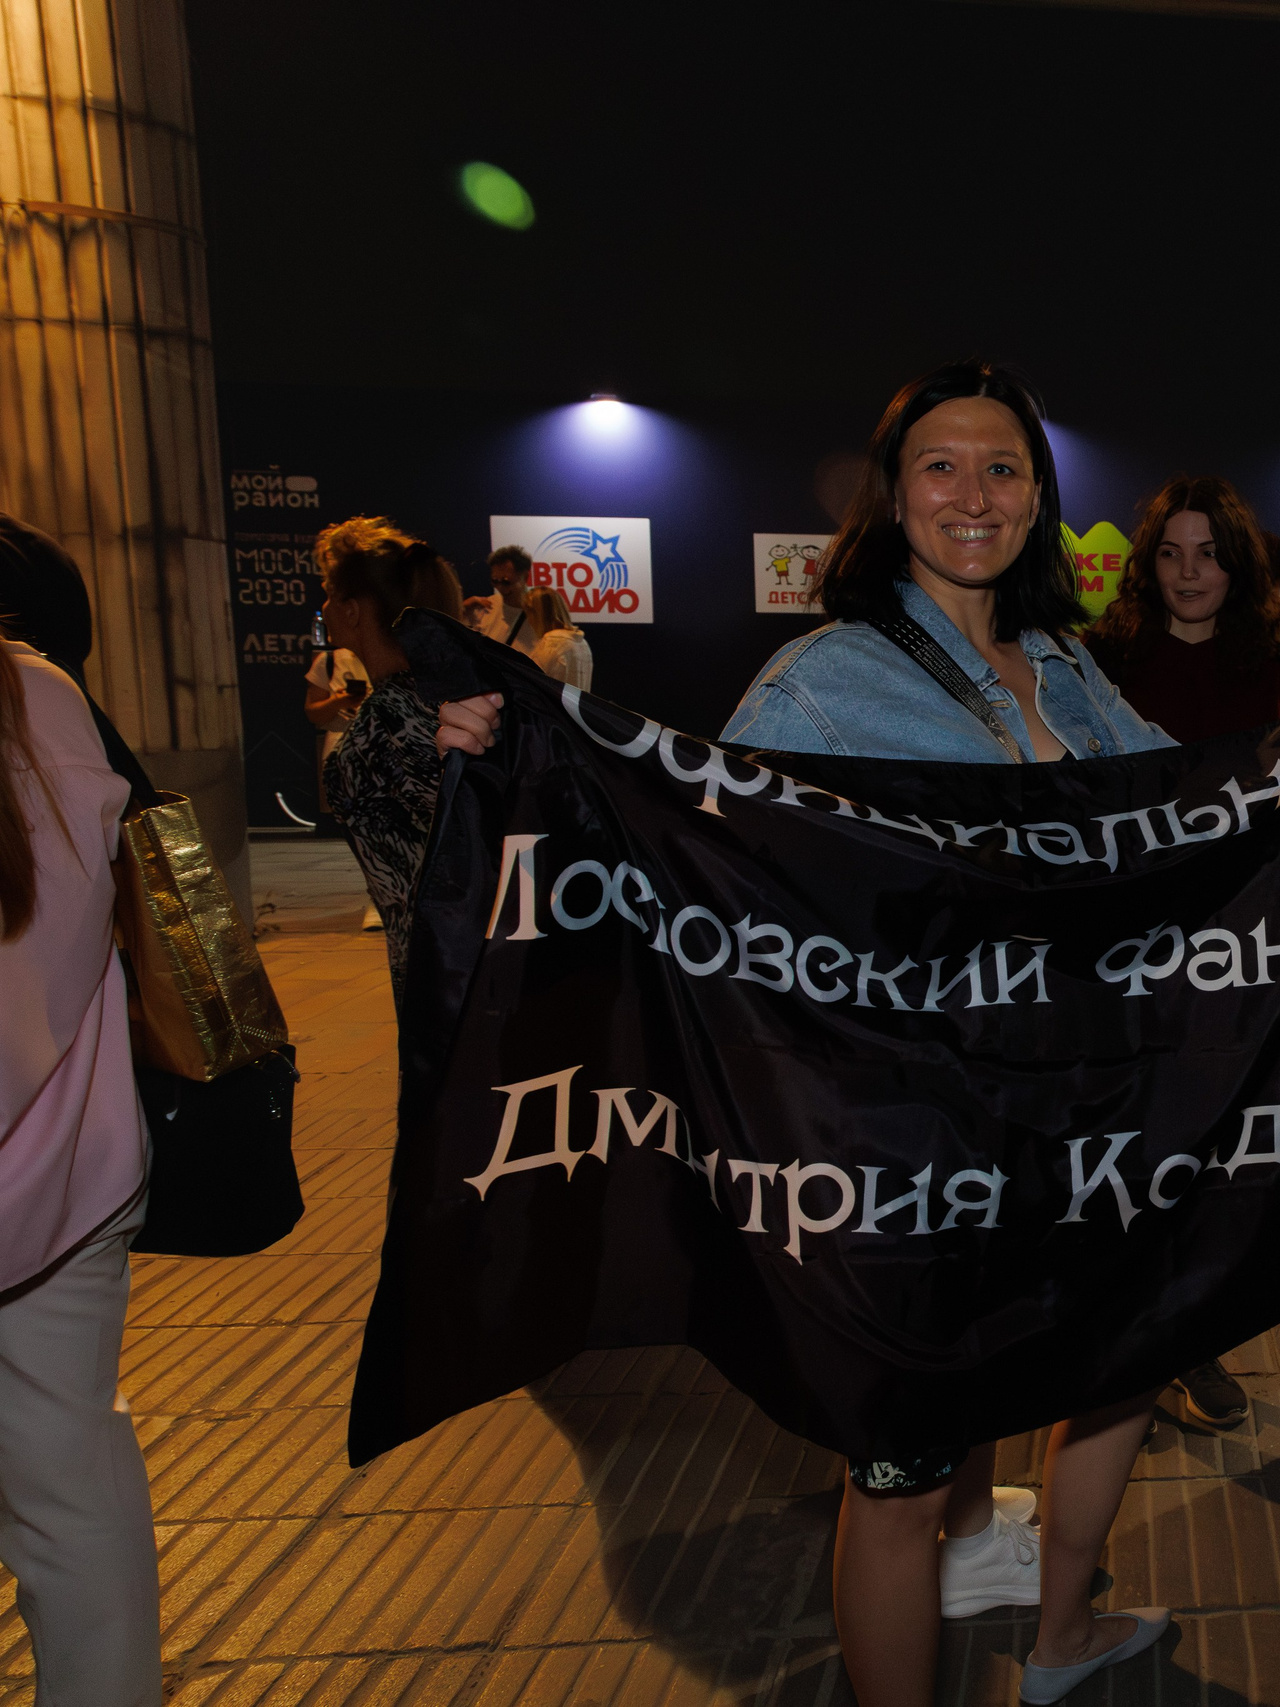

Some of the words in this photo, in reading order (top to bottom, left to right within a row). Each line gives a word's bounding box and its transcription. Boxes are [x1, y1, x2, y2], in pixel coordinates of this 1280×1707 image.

[234, 548, 321, 576] МОСК
[526, 562, 594, 588] ВТО
[238, 578, 306, 606] 2030
[560, 588, 640, 614] ДИО
